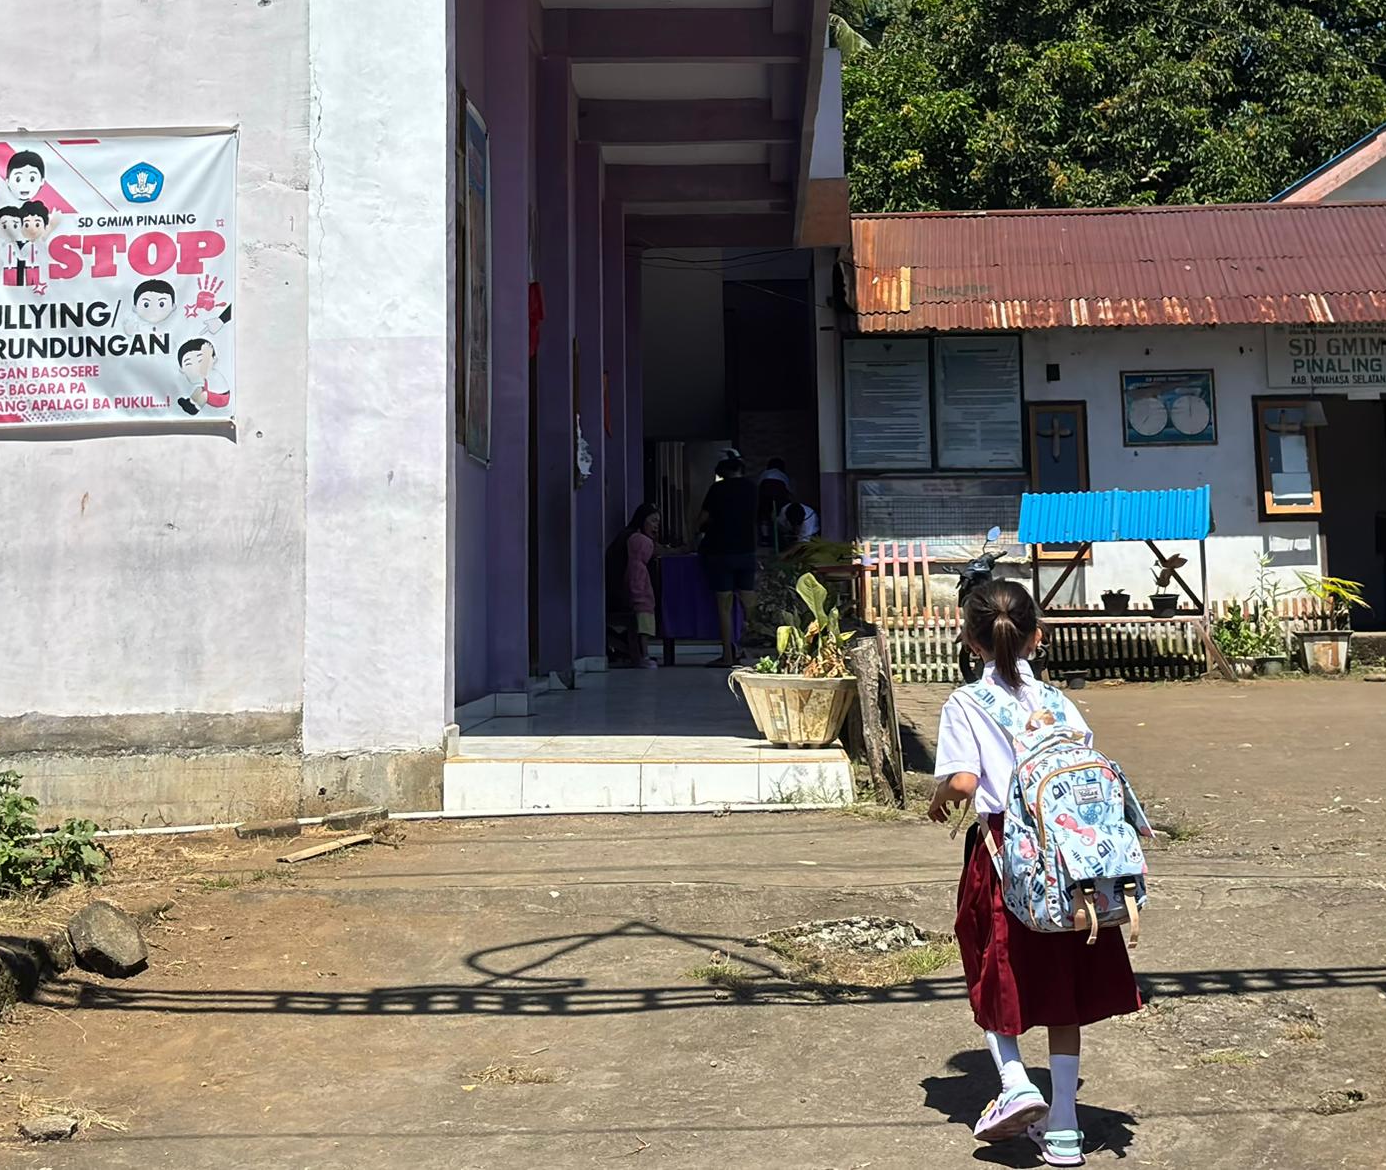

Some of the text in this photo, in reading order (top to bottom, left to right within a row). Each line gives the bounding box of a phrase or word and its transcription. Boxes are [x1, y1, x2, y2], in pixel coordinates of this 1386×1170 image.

[78, 214, 197, 228] SD GMIM PINALING
[48, 230, 226, 279] STOP
[1327, 338, 1385, 356] GMIM
[32, 366, 99, 378] BASOSERE
[1293, 358, 1382, 373] PINALING
[1311, 375, 1349, 384] MINAHASA
[1353, 375, 1386, 384] SELATAN
[9, 383, 66, 396] BAGARA
[70, 382, 86, 394] PA
[32, 398, 88, 411] APALAGI
[93, 398, 110, 409] BA
[115, 396, 170, 409] PUKUL...!
